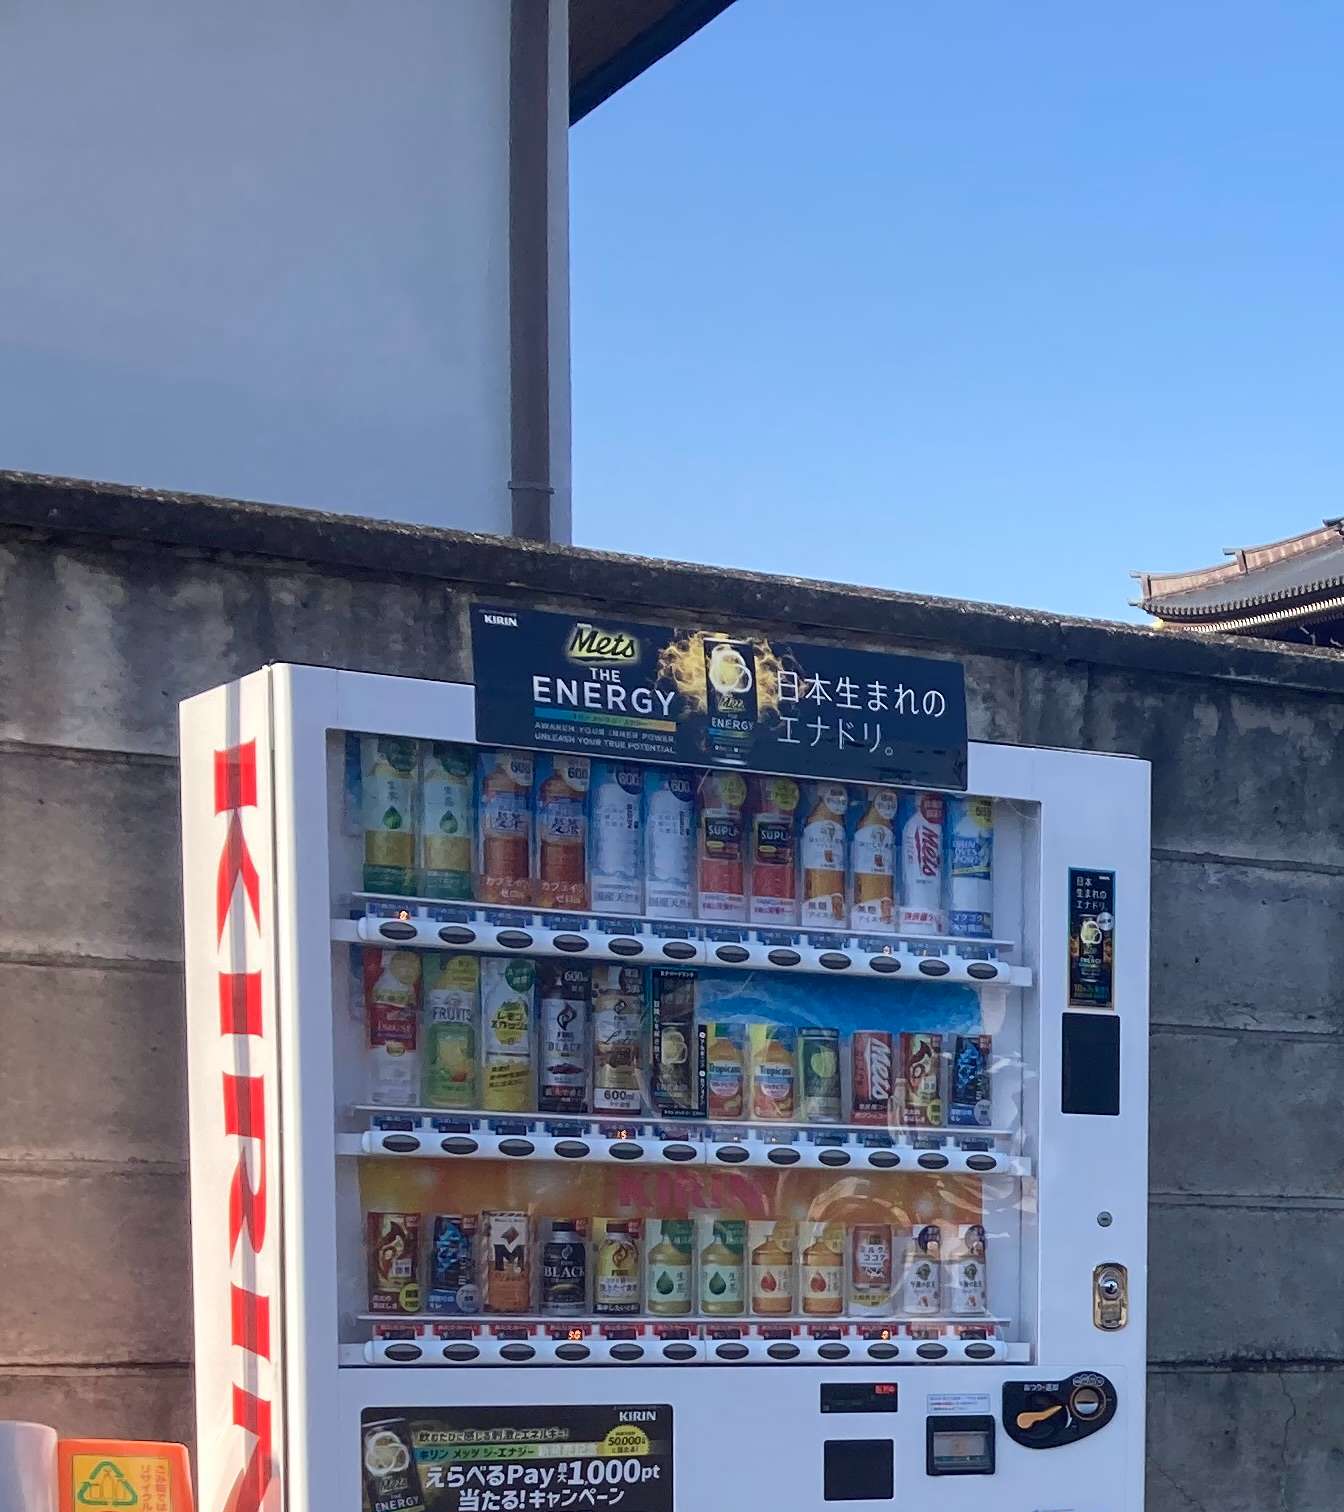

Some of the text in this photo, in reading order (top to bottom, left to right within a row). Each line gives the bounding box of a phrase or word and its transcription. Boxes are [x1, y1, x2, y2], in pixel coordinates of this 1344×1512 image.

[484, 614, 518, 628] KIRIN
[570, 624, 636, 661] Mets
[589, 667, 621, 683] THE
[533, 675, 675, 716] ENERGY
[777, 670, 946, 718] 日本生まれの
[578, 725, 606, 737] YOUR
[777, 715, 894, 756] エナドリ。
[578, 736, 602, 747] YOUR
[604, 739, 626, 750] TRUE
[921, 825, 941, 877] Mets
[1076, 889, 1108, 899] 生まれの
[432, 1006, 472, 1021] FRUITS
[544, 1266, 585, 1278] BLACK
[619, 1411, 657, 1422] KIRIN
[457, 1487, 625, 1512] 当たる!キャンペーン
